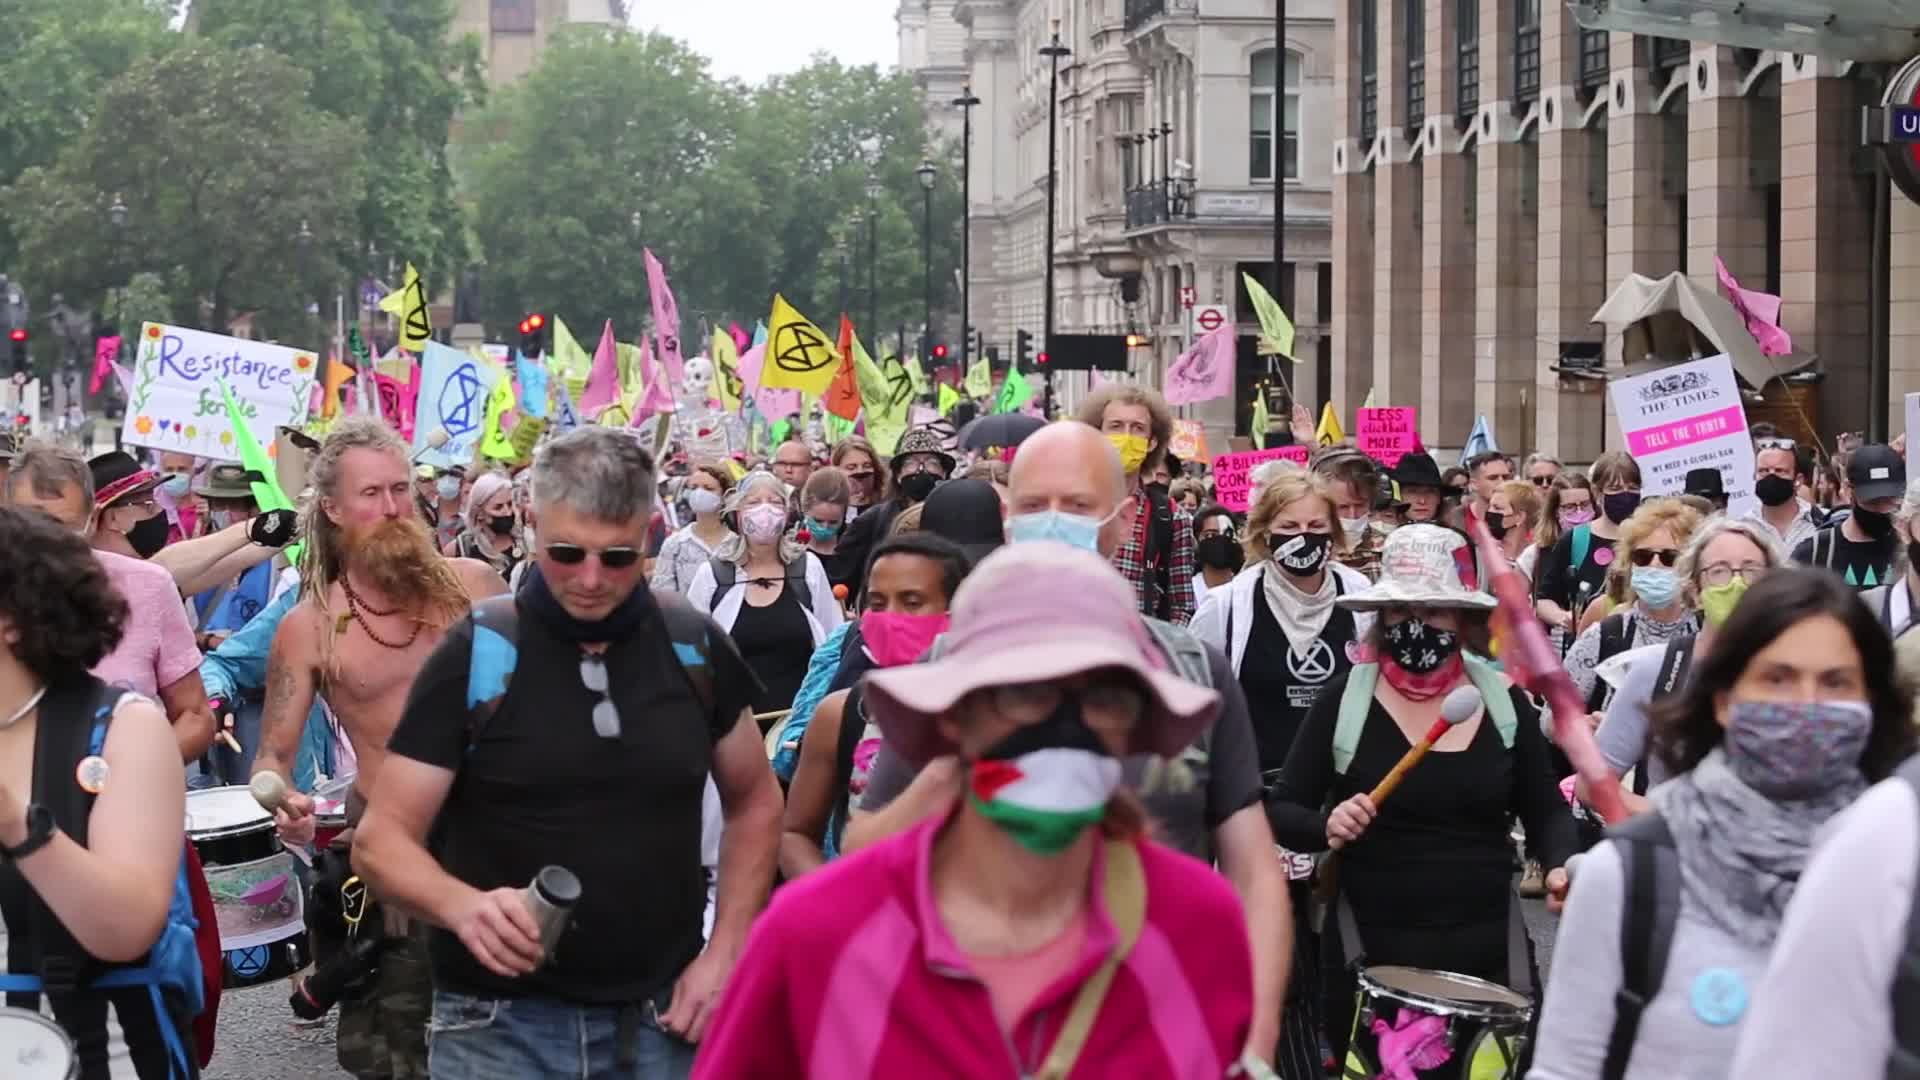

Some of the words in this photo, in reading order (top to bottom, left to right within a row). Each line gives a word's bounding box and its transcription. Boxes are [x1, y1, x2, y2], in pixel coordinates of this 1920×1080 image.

[1902, 115, 1920, 134] U
[159, 335, 292, 389] Resistance
[193, 388, 257, 418] femle
[1640, 402, 1669, 416] THE
[1674, 389, 1720, 406] TIMES
[1367, 408, 1404, 421] LESS
[1645, 432, 1669, 448] TELL
[1672, 425, 1691, 441] THE
[1695, 416, 1727, 435] TRUTH
[1367, 437, 1401, 448] MORE
[1216, 456, 1229, 471] 4
[1689, 452, 1718, 465] GLOBAL
[1719, 448, 1734, 458] BAN
[1218, 472, 1248, 488] CON
